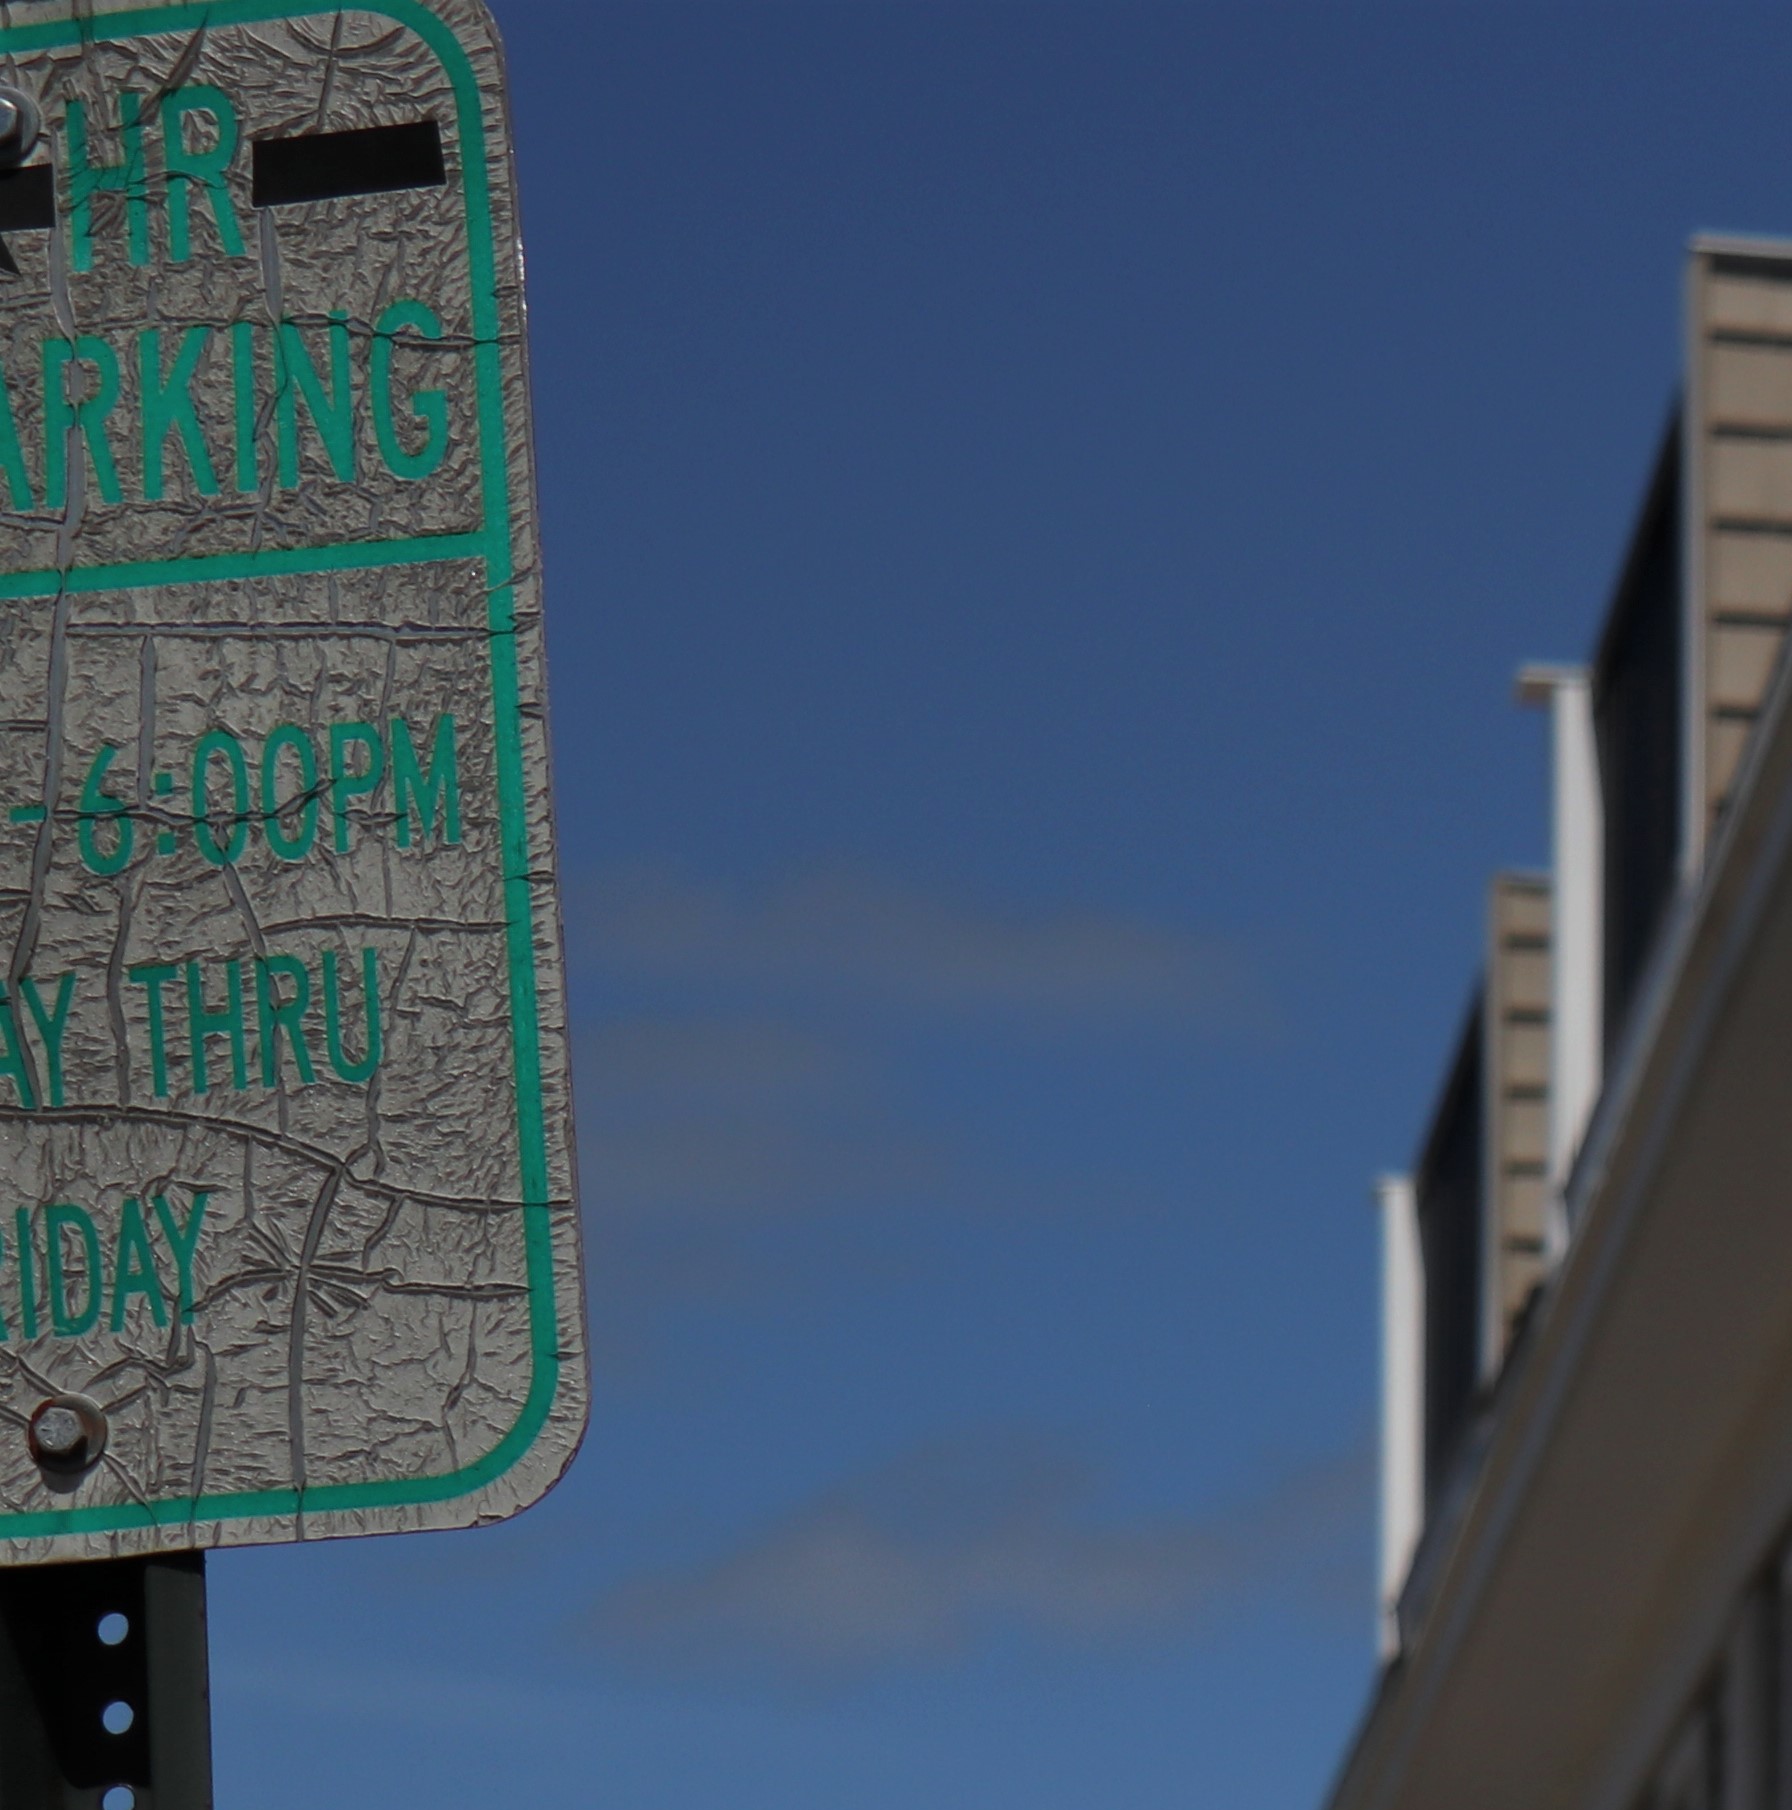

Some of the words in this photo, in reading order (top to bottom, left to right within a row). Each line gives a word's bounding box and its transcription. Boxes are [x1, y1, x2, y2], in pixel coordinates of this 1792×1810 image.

[64, 84, 247, 273] HR
[129, 947, 383, 1098] THRU
[0, 1192, 209, 1342] IDAY
